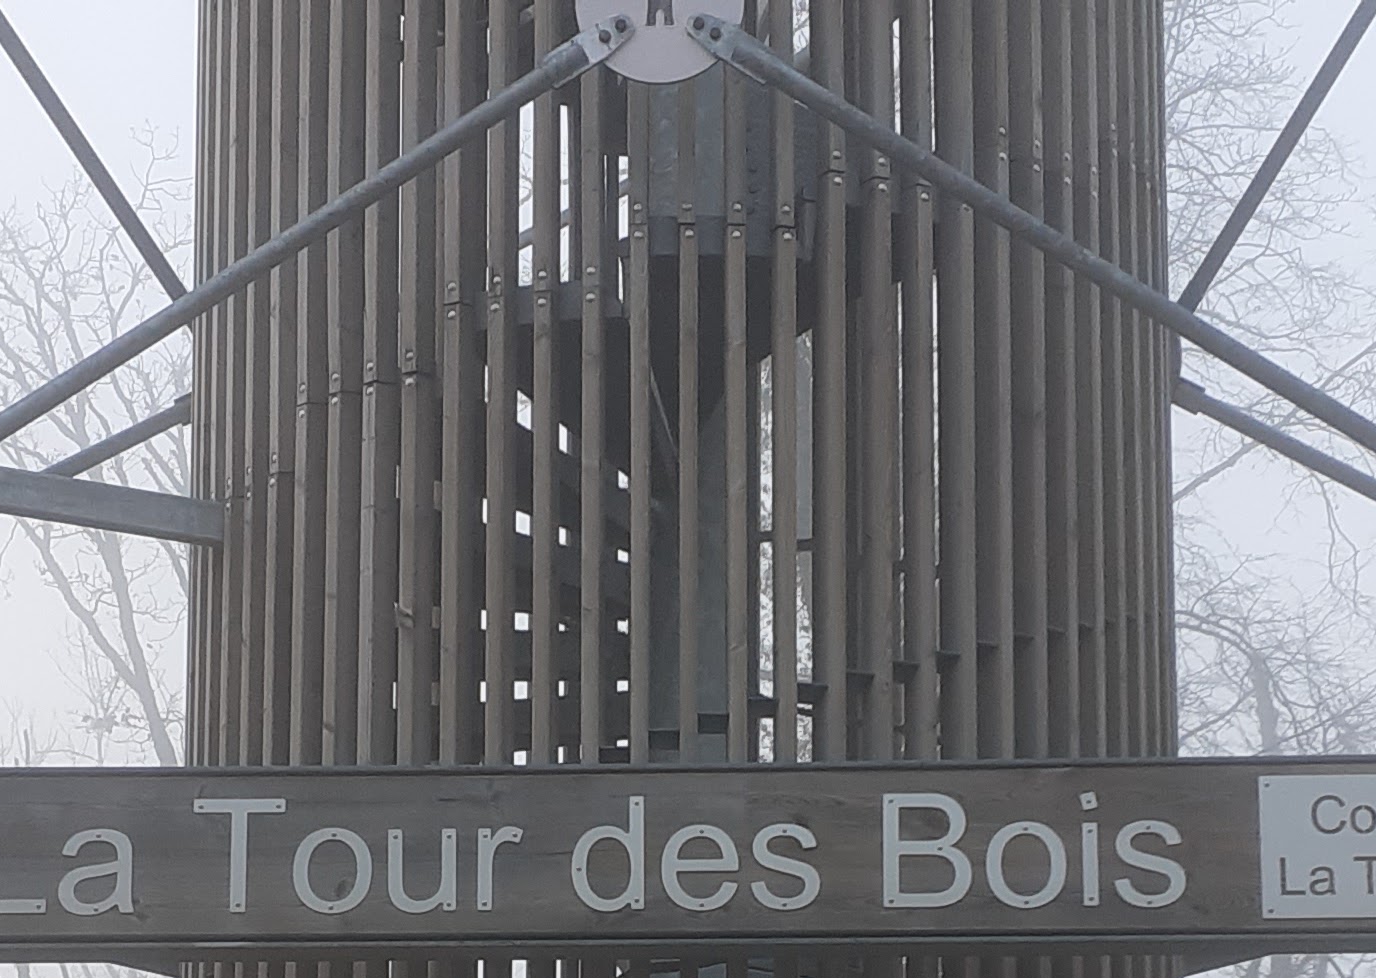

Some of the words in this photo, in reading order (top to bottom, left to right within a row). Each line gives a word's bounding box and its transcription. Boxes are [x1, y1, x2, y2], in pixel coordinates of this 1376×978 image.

[192, 797, 524, 914] Tour
[571, 795, 821, 912] des
[882, 791, 1187, 909] Bois
[1279, 856, 1337, 896] La
